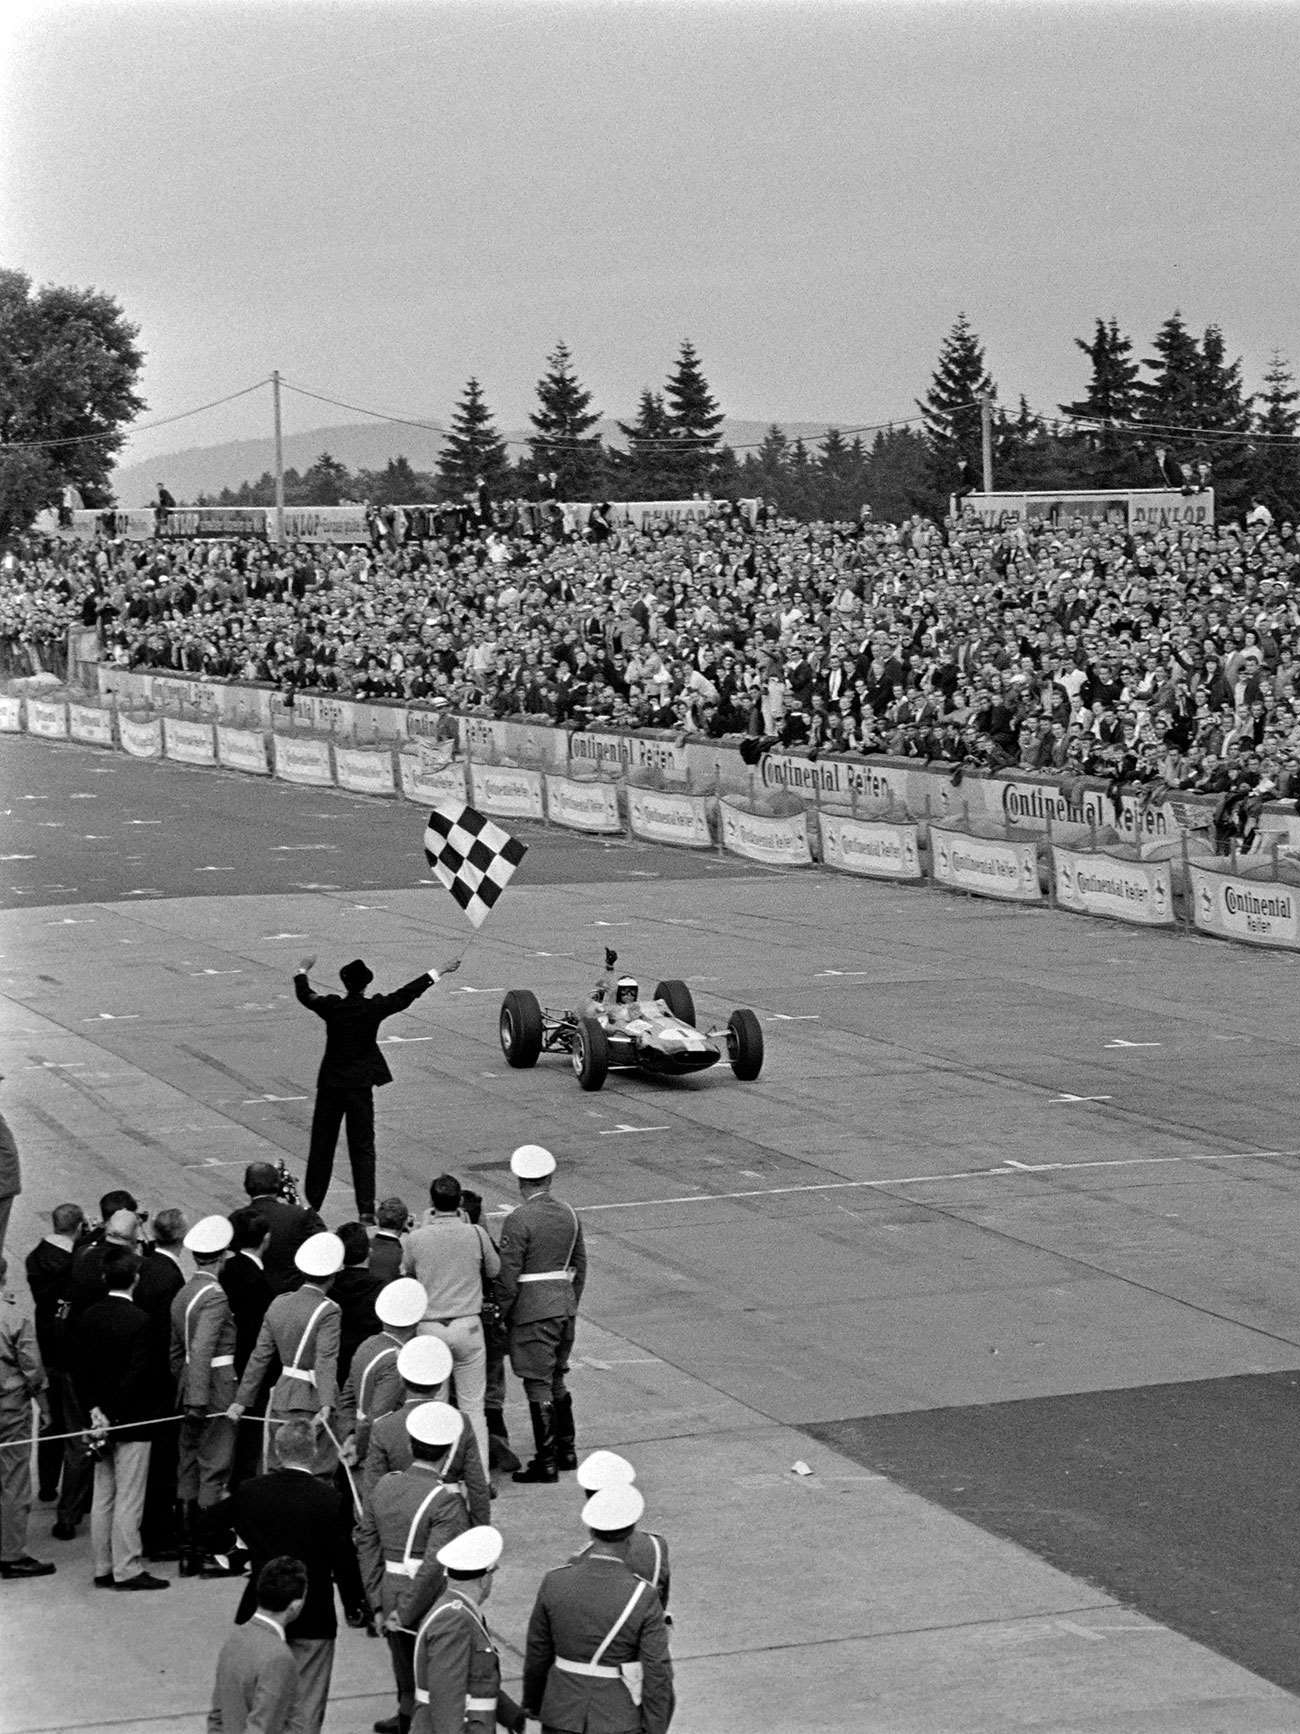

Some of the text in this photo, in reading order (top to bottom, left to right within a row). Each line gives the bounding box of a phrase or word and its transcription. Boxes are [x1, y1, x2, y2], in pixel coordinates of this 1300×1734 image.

[761, 754, 889, 797] Continental Reifen
[1003, 783, 1104, 827] Continental
[1225, 886, 1292, 920] Continental
